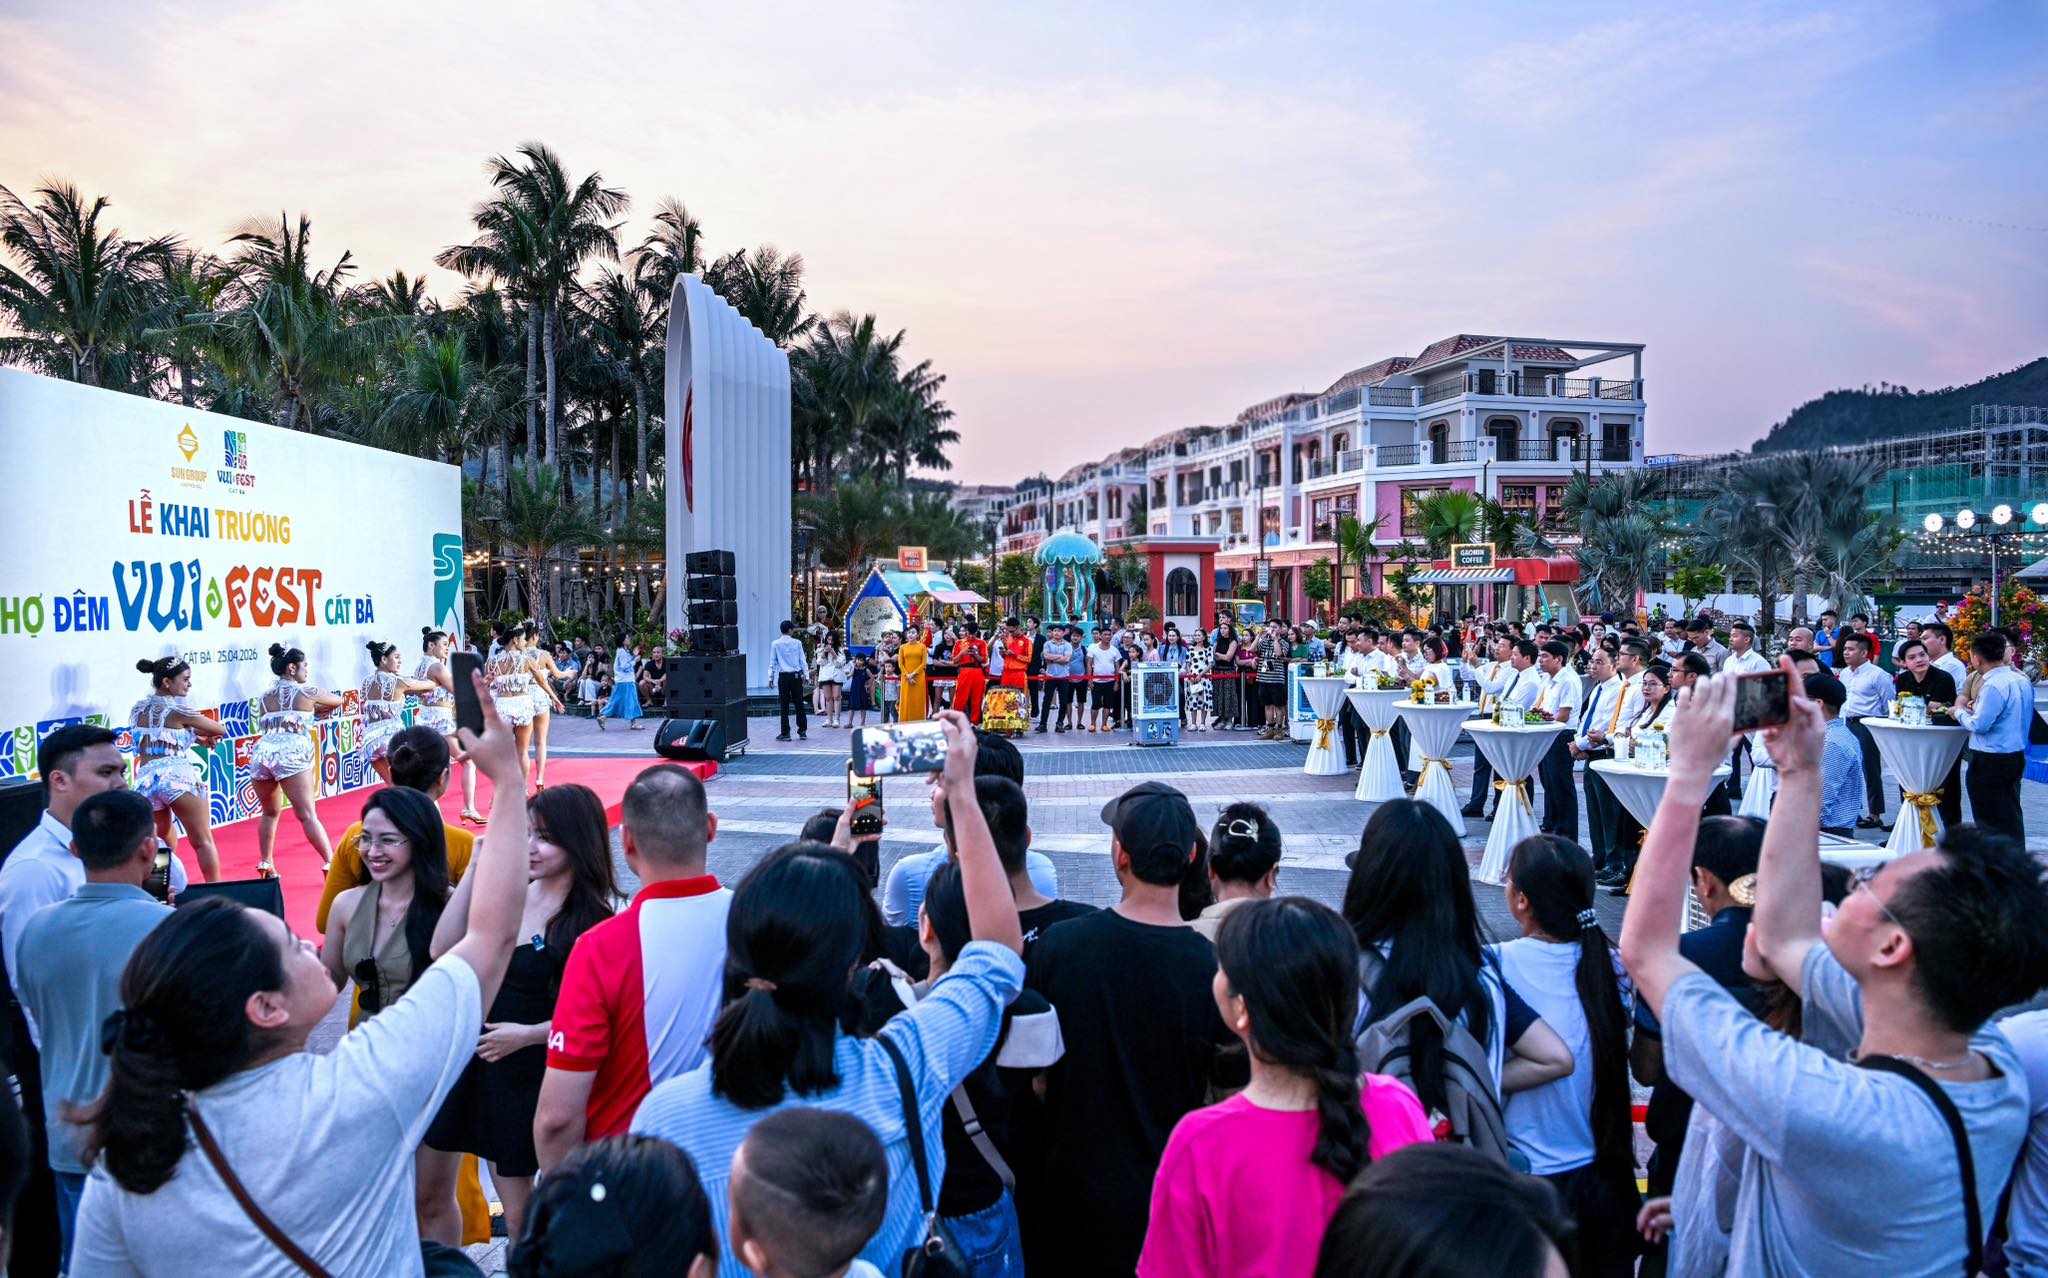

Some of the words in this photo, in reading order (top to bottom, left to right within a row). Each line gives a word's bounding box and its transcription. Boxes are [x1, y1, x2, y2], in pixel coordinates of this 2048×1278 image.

[171, 467, 186, 480] SUN
[186, 469, 208, 483] GROUP
[235, 473, 256, 487] FEST
[129, 488, 153, 534] LỄ
[160, 502, 210, 538] KHAI
[214, 508, 291, 545] TRƯƠNG
[1461, 556, 1484, 564] COFFEE
[0, 592, 45, 638] HỢ
[53, 588, 110, 632] ĐÊM
[112, 558, 203, 633] VUI
[225, 564, 322, 628] FEST
[324, 593, 351, 625] CÁT
[355, 593, 375, 624] BÀ
[200, 649, 212, 664] BÀ
[217, 648, 258, 663] 25.04.2026
